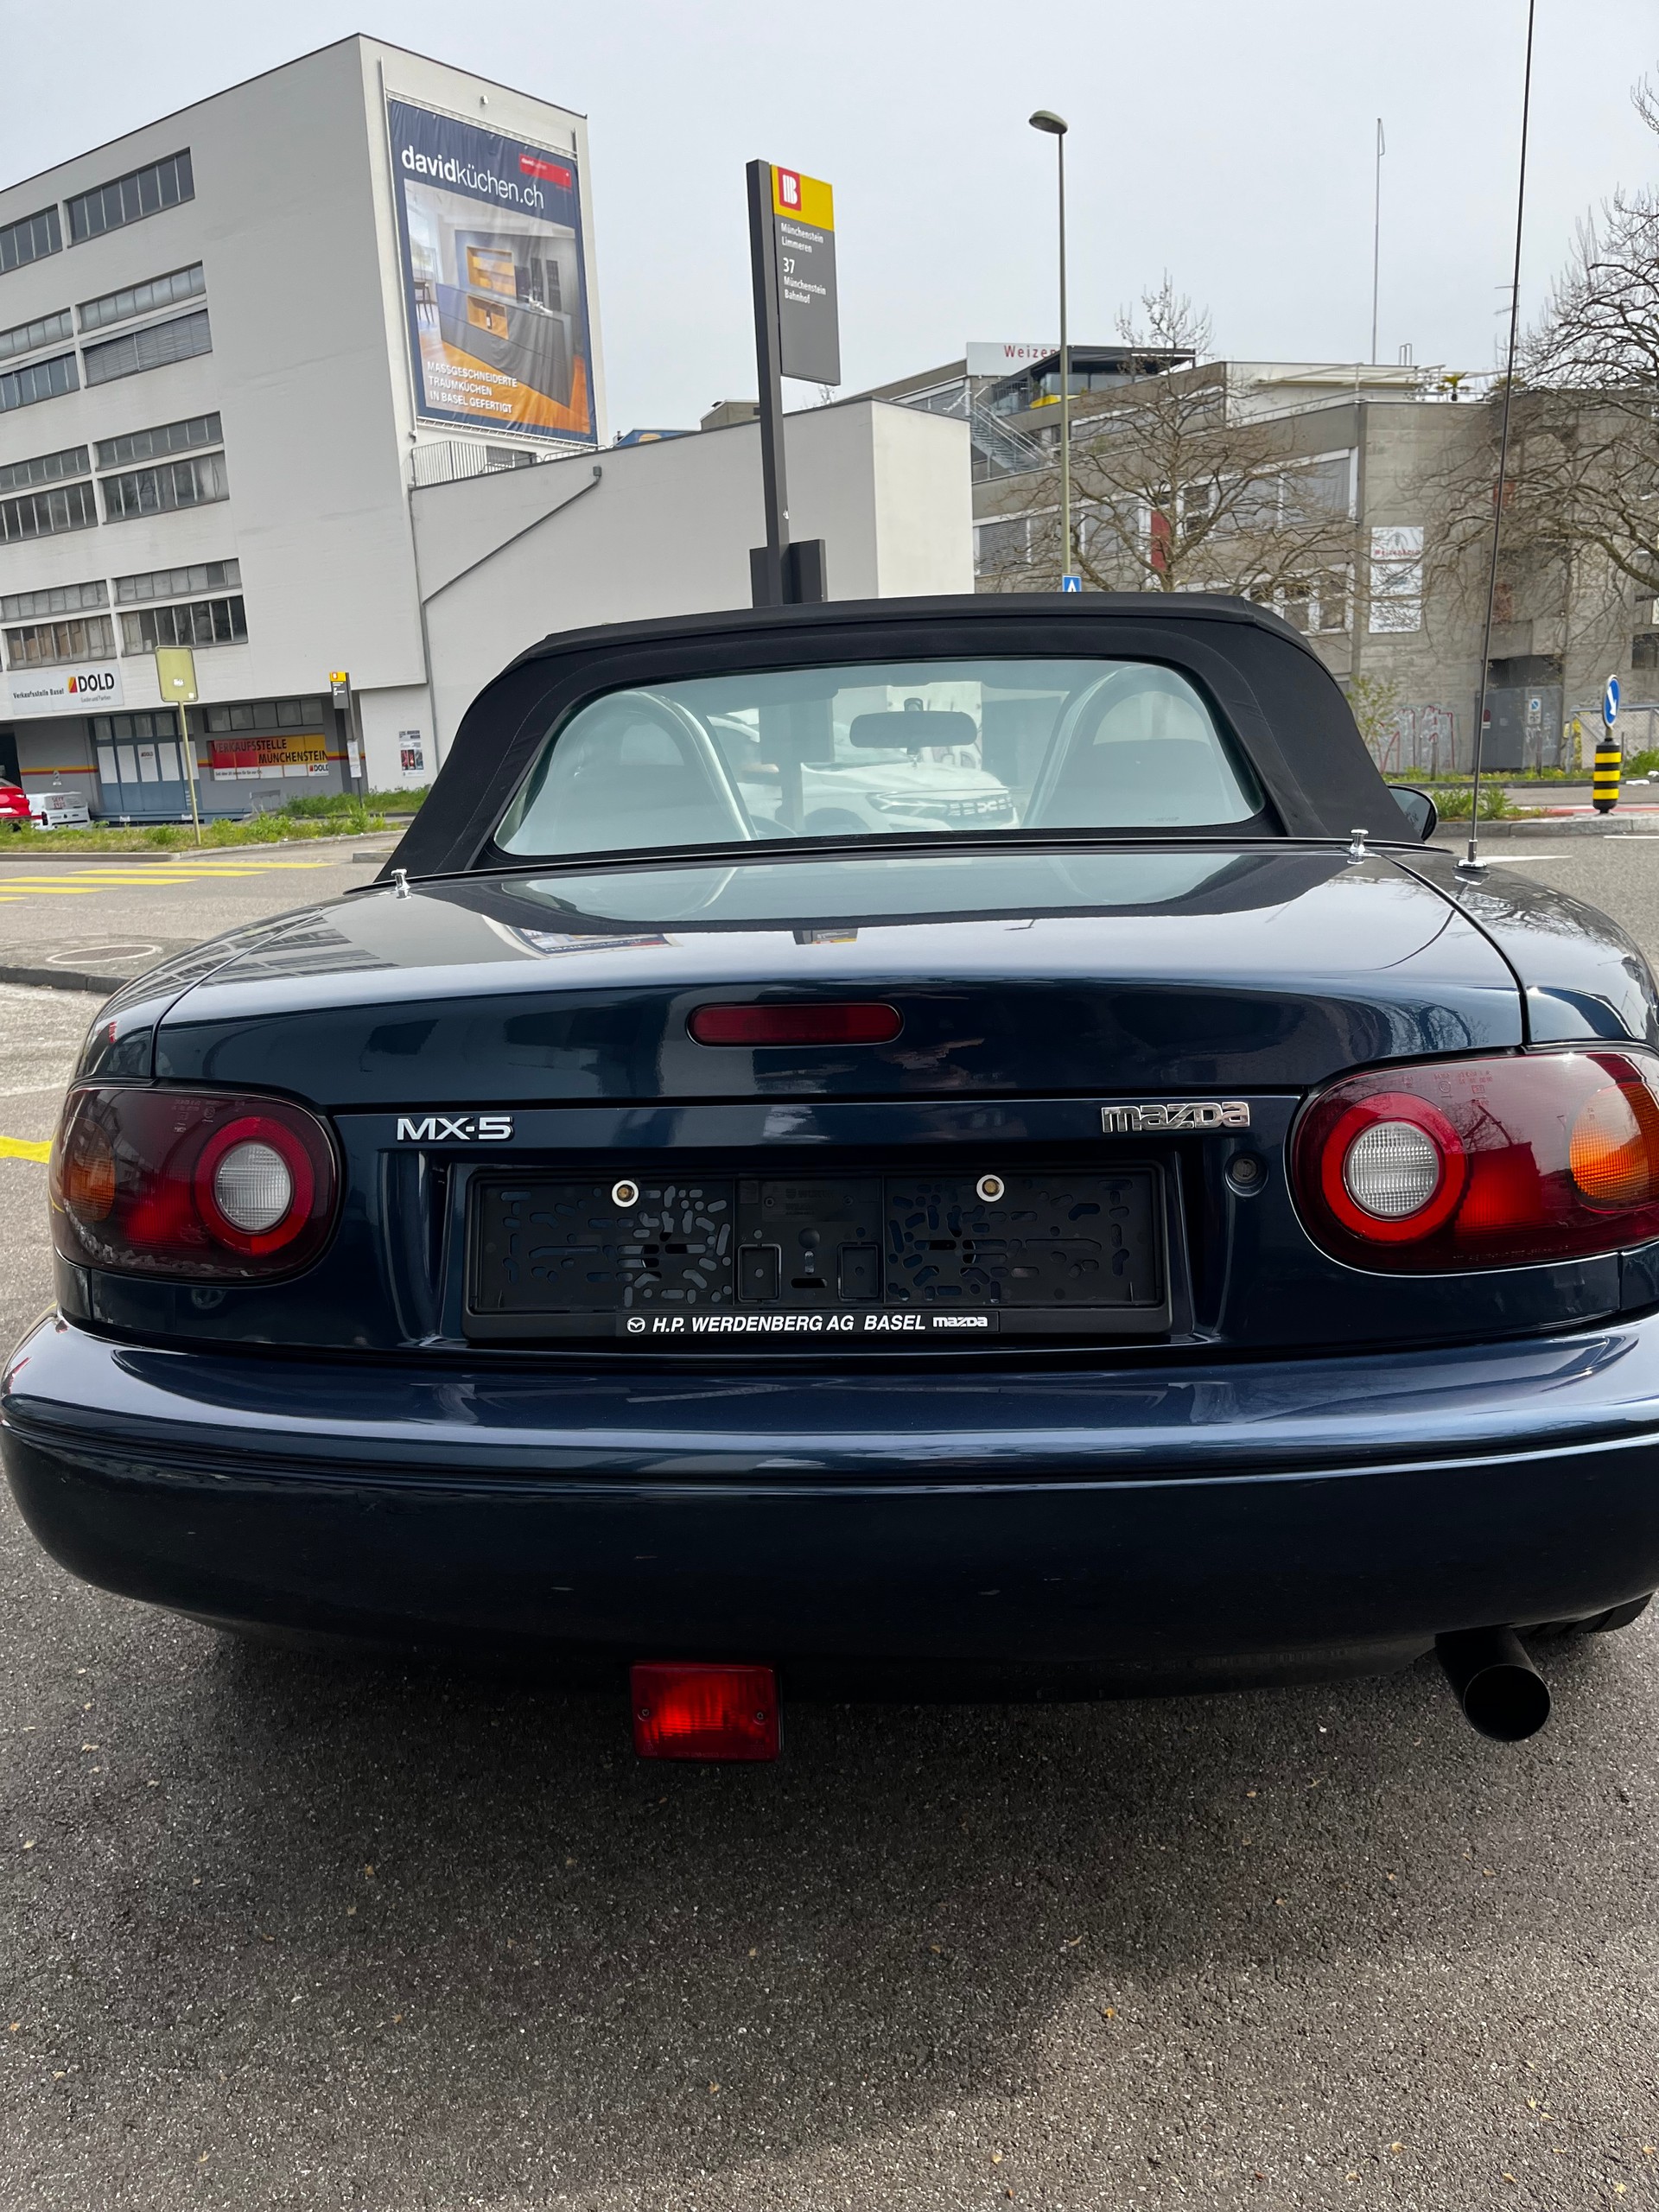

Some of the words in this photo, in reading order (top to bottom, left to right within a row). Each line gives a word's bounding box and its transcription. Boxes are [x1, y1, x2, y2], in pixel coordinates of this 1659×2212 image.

[402, 145, 543, 209] davidküchen.ch
[781, 222, 824, 244] Münchenstein
[781, 236, 812, 253] Limmeren
[783, 257, 795, 274] 37
[784, 276, 826, 296] Münchenstein
[785, 289, 810, 304] Bahnhof
[427, 361, 518, 387] MASSGESCHNEIDERTE
[428, 375, 493, 397] TRAUMKÜCHEN
[429, 390, 440, 401] IN
[441, 392, 468, 406] BASEL
[469, 397, 512, 413] GEFERTIGT
[78, 673, 115, 692] DOLD
[213, 739, 287, 753] VERKAUFSSTELLE
[258, 750, 328, 764] MÜNCHENSTEIN
[1100, 1101, 1251, 1134] mazda
[396, 1116, 514, 1142] MX-5
[652, 1317, 685, 1333] H.P.
[692, 1315, 823, 1332] WERDENBERG
[826, 1315, 855, 1332] AG
[864, 1314, 926, 1332] BASEL
[932, 1315, 988, 1328] mazda
